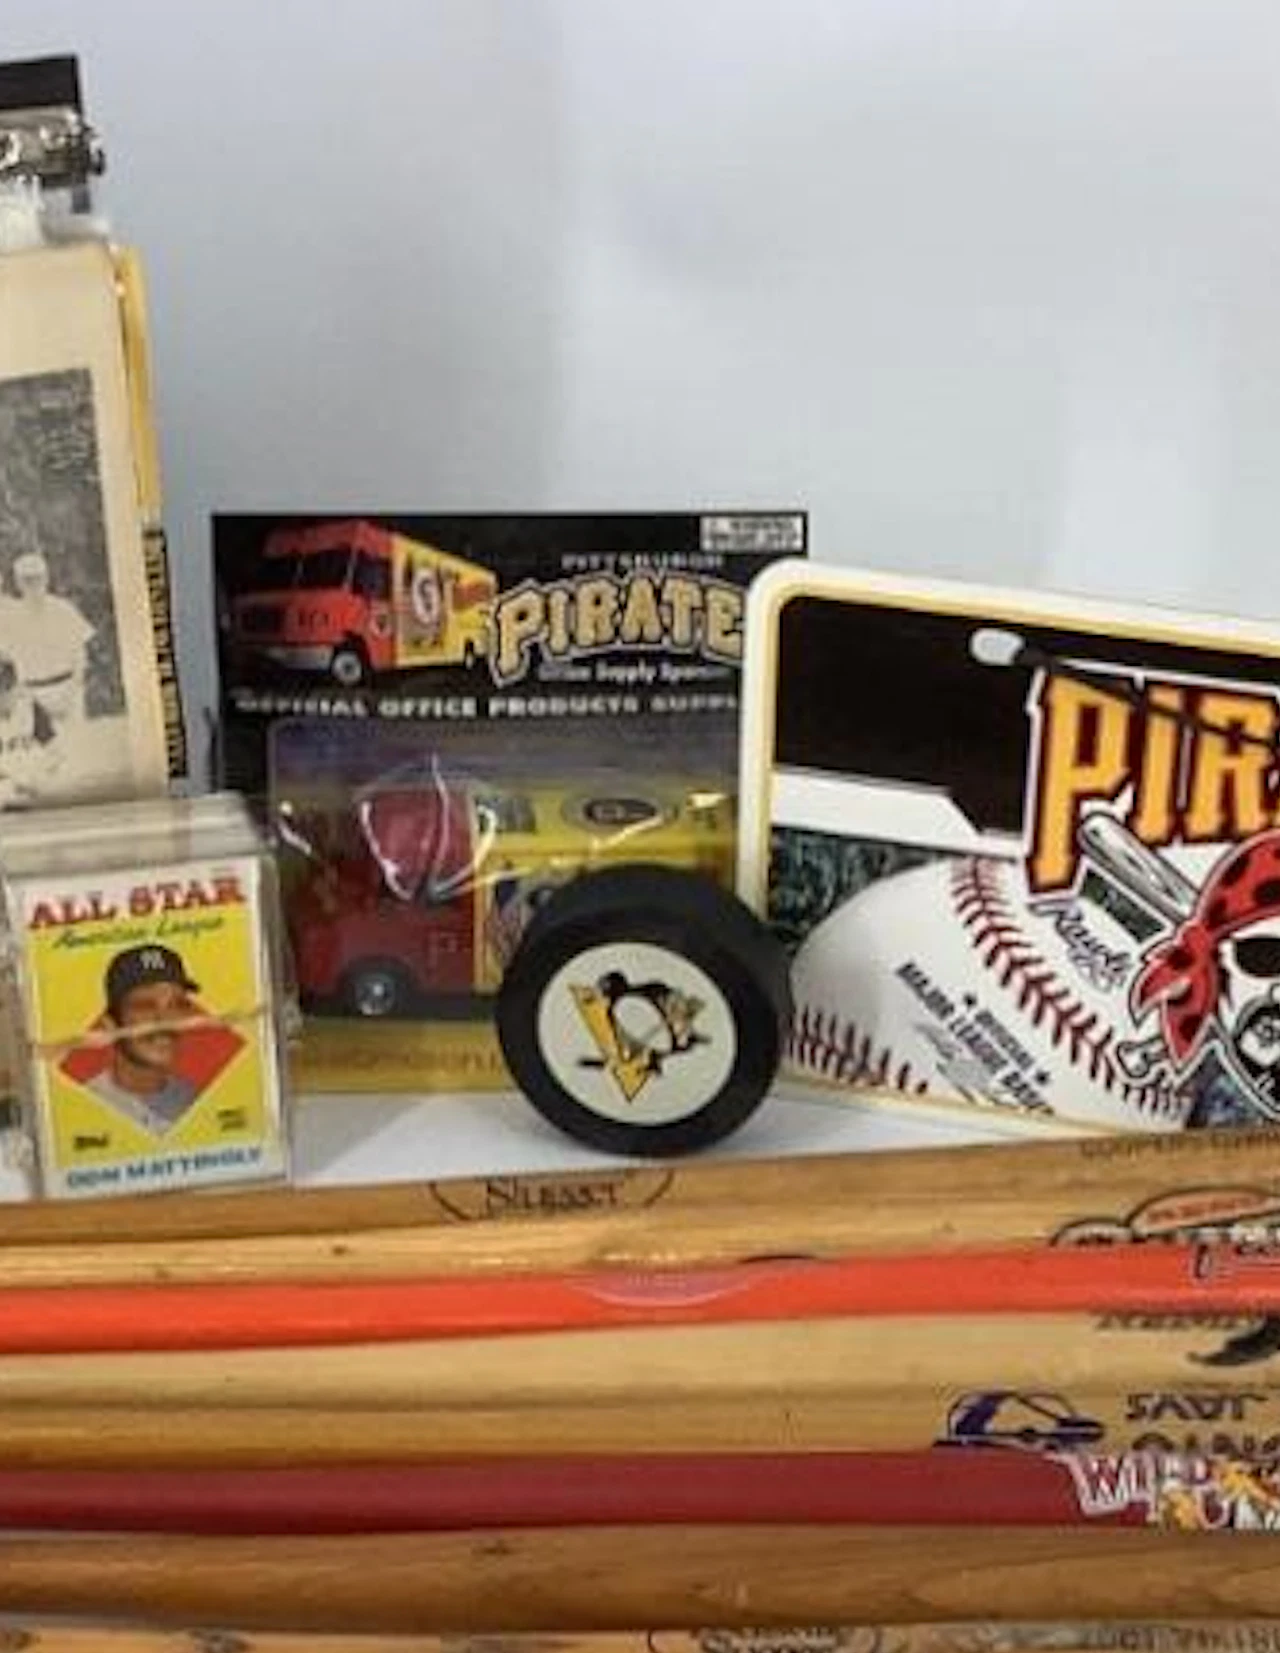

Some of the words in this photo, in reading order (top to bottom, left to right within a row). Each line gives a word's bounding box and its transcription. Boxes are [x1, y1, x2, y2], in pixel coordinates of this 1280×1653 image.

[494, 573, 745, 680] PIRATE
[377, 695, 478, 718] OFFICE
[488, 695, 640, 716] PRODUCTS
[27, 888, 118, 931] ALL
[128, 874, 248, 916] STAR
[1124, 1393, 1268, 1425] JAYS
